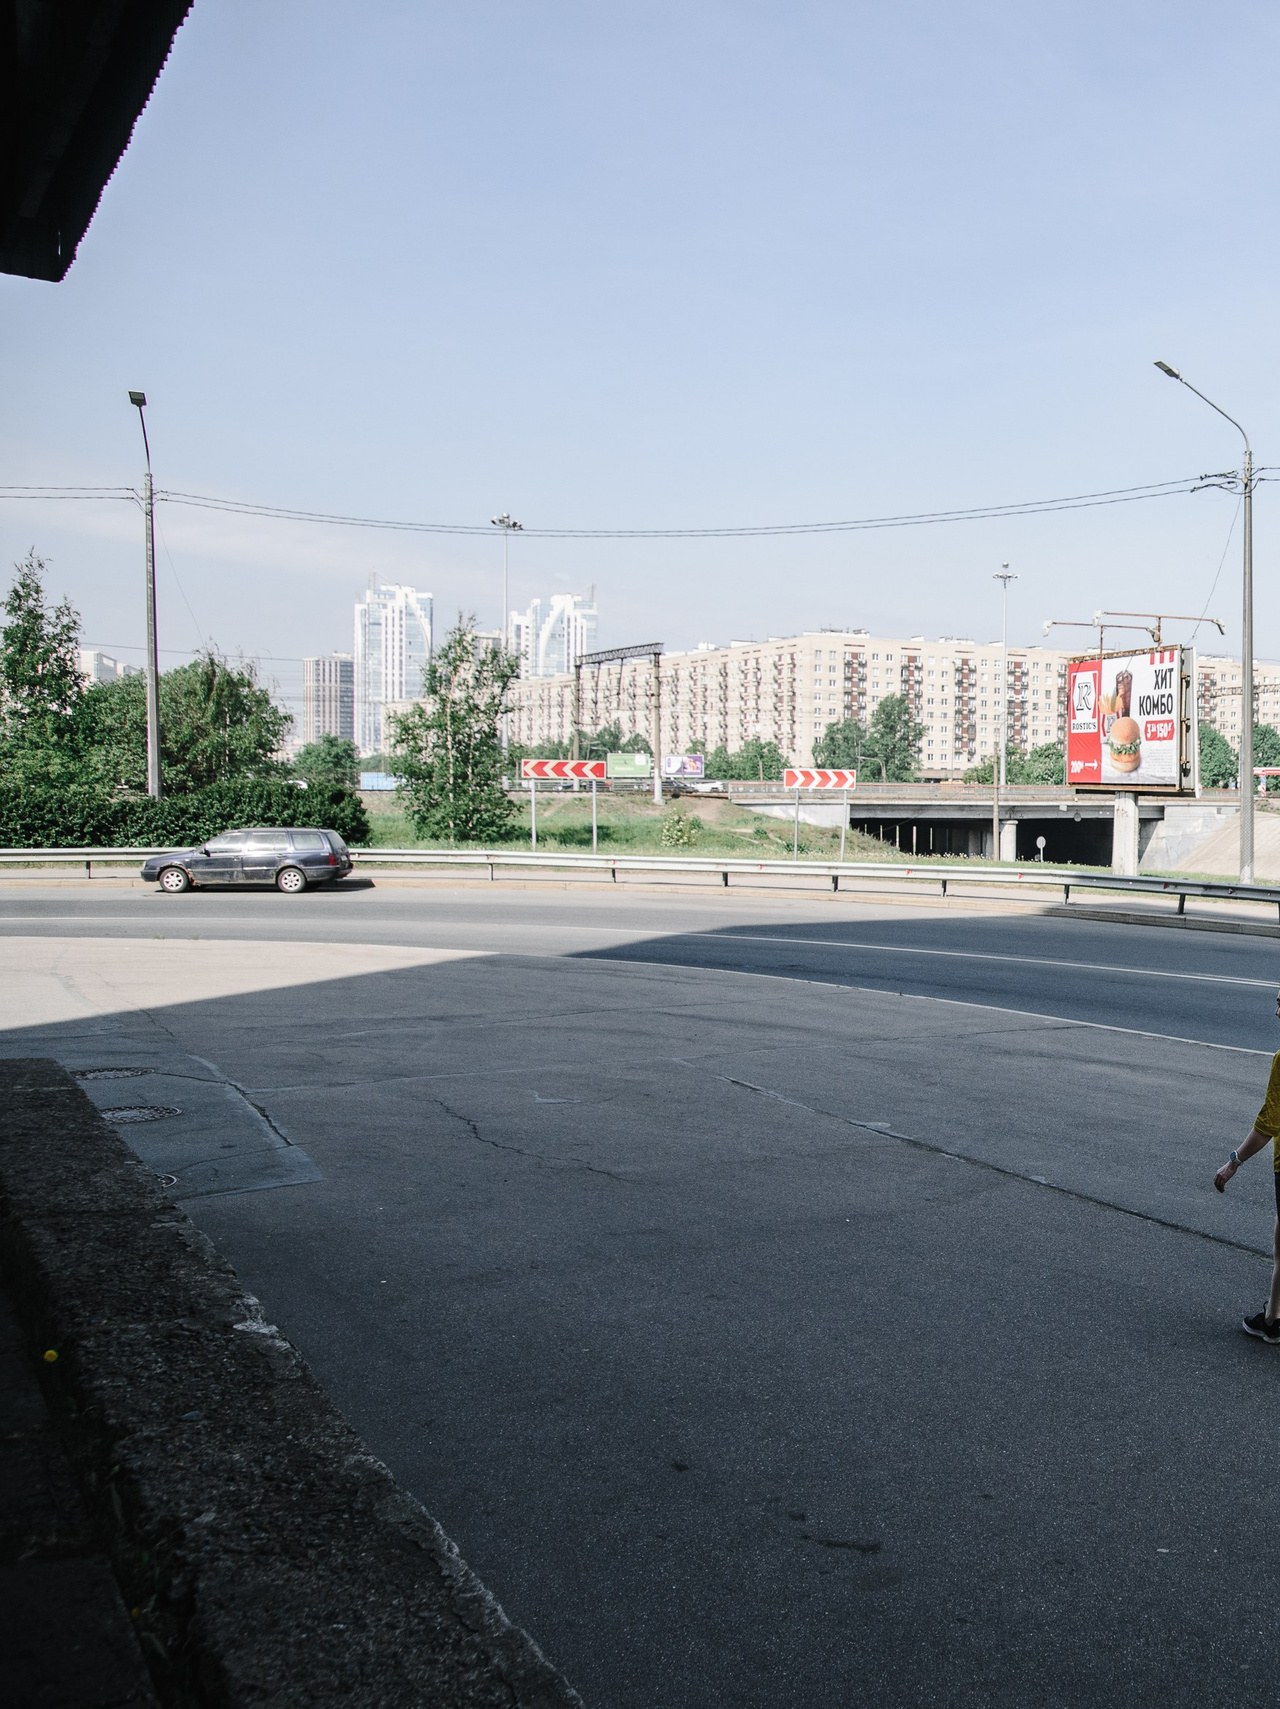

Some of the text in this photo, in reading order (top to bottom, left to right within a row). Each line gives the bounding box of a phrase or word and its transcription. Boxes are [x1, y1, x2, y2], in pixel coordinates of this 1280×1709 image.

[1154, 668, 1174, 690] ХИТ
[1076, 682, 1092, 711] R
[1139, 693, 1174, 716] КОМБО
[1072, 722, 1097, 731] ROSTIC'S
